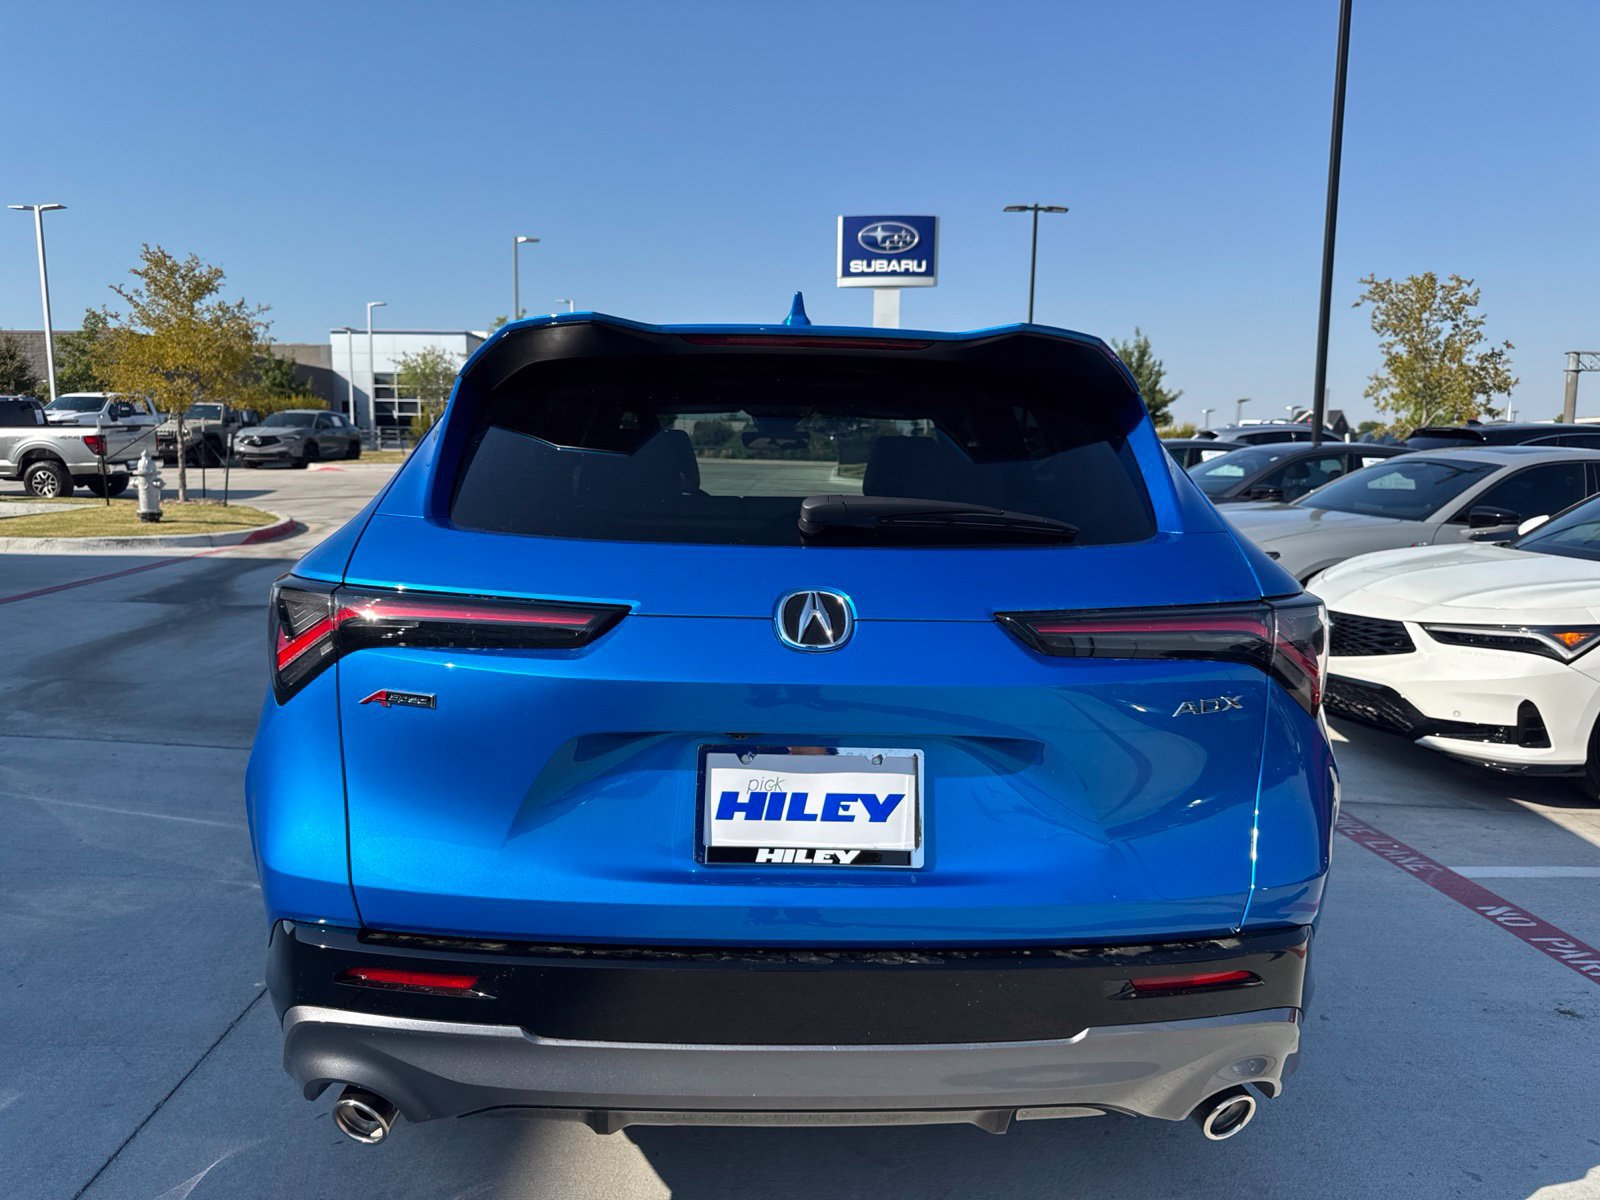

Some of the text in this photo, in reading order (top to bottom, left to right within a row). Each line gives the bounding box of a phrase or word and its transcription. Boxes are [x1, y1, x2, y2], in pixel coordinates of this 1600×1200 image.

[849, 259, 927, 273] SUBARU
[1172, 695, 1244, 718] ADX
[747, 776, 785, 794] pick
[715, 791, 906, 822] HILEY
[755, 848, 861, 864] HILEY
[1363, 840, 1443, 872] LANE
[1476, 905, 1537, 927] NO
